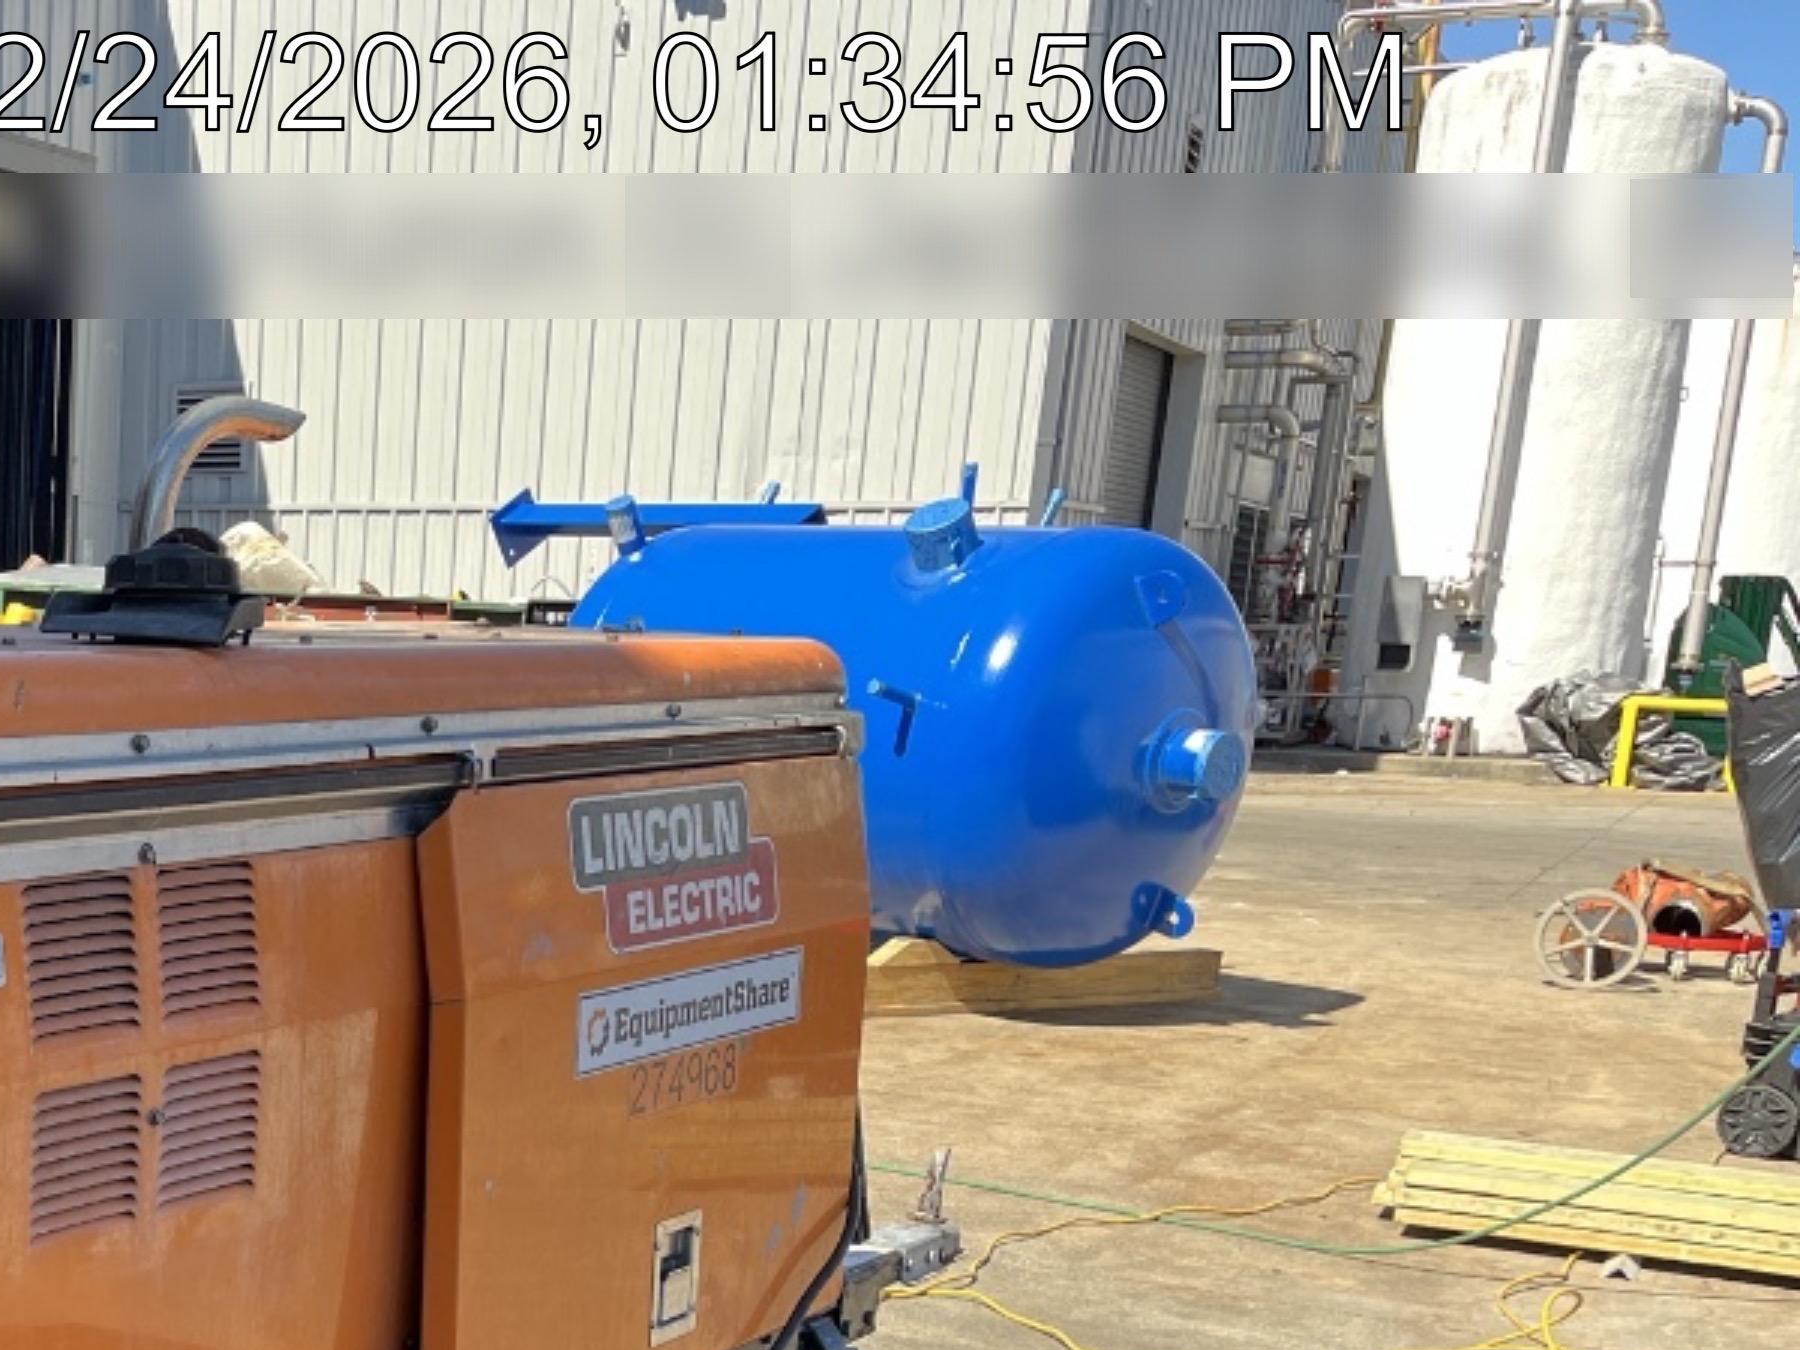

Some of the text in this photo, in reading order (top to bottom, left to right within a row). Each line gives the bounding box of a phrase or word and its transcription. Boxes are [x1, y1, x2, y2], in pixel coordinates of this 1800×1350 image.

[580, 800, 742, 875] LINCOLN
[626, 871, 763, 935] ELECTRIC
[613, 977, 792, 1048] EquipmentShare
[629, 1044, 737, 1117] 274968
